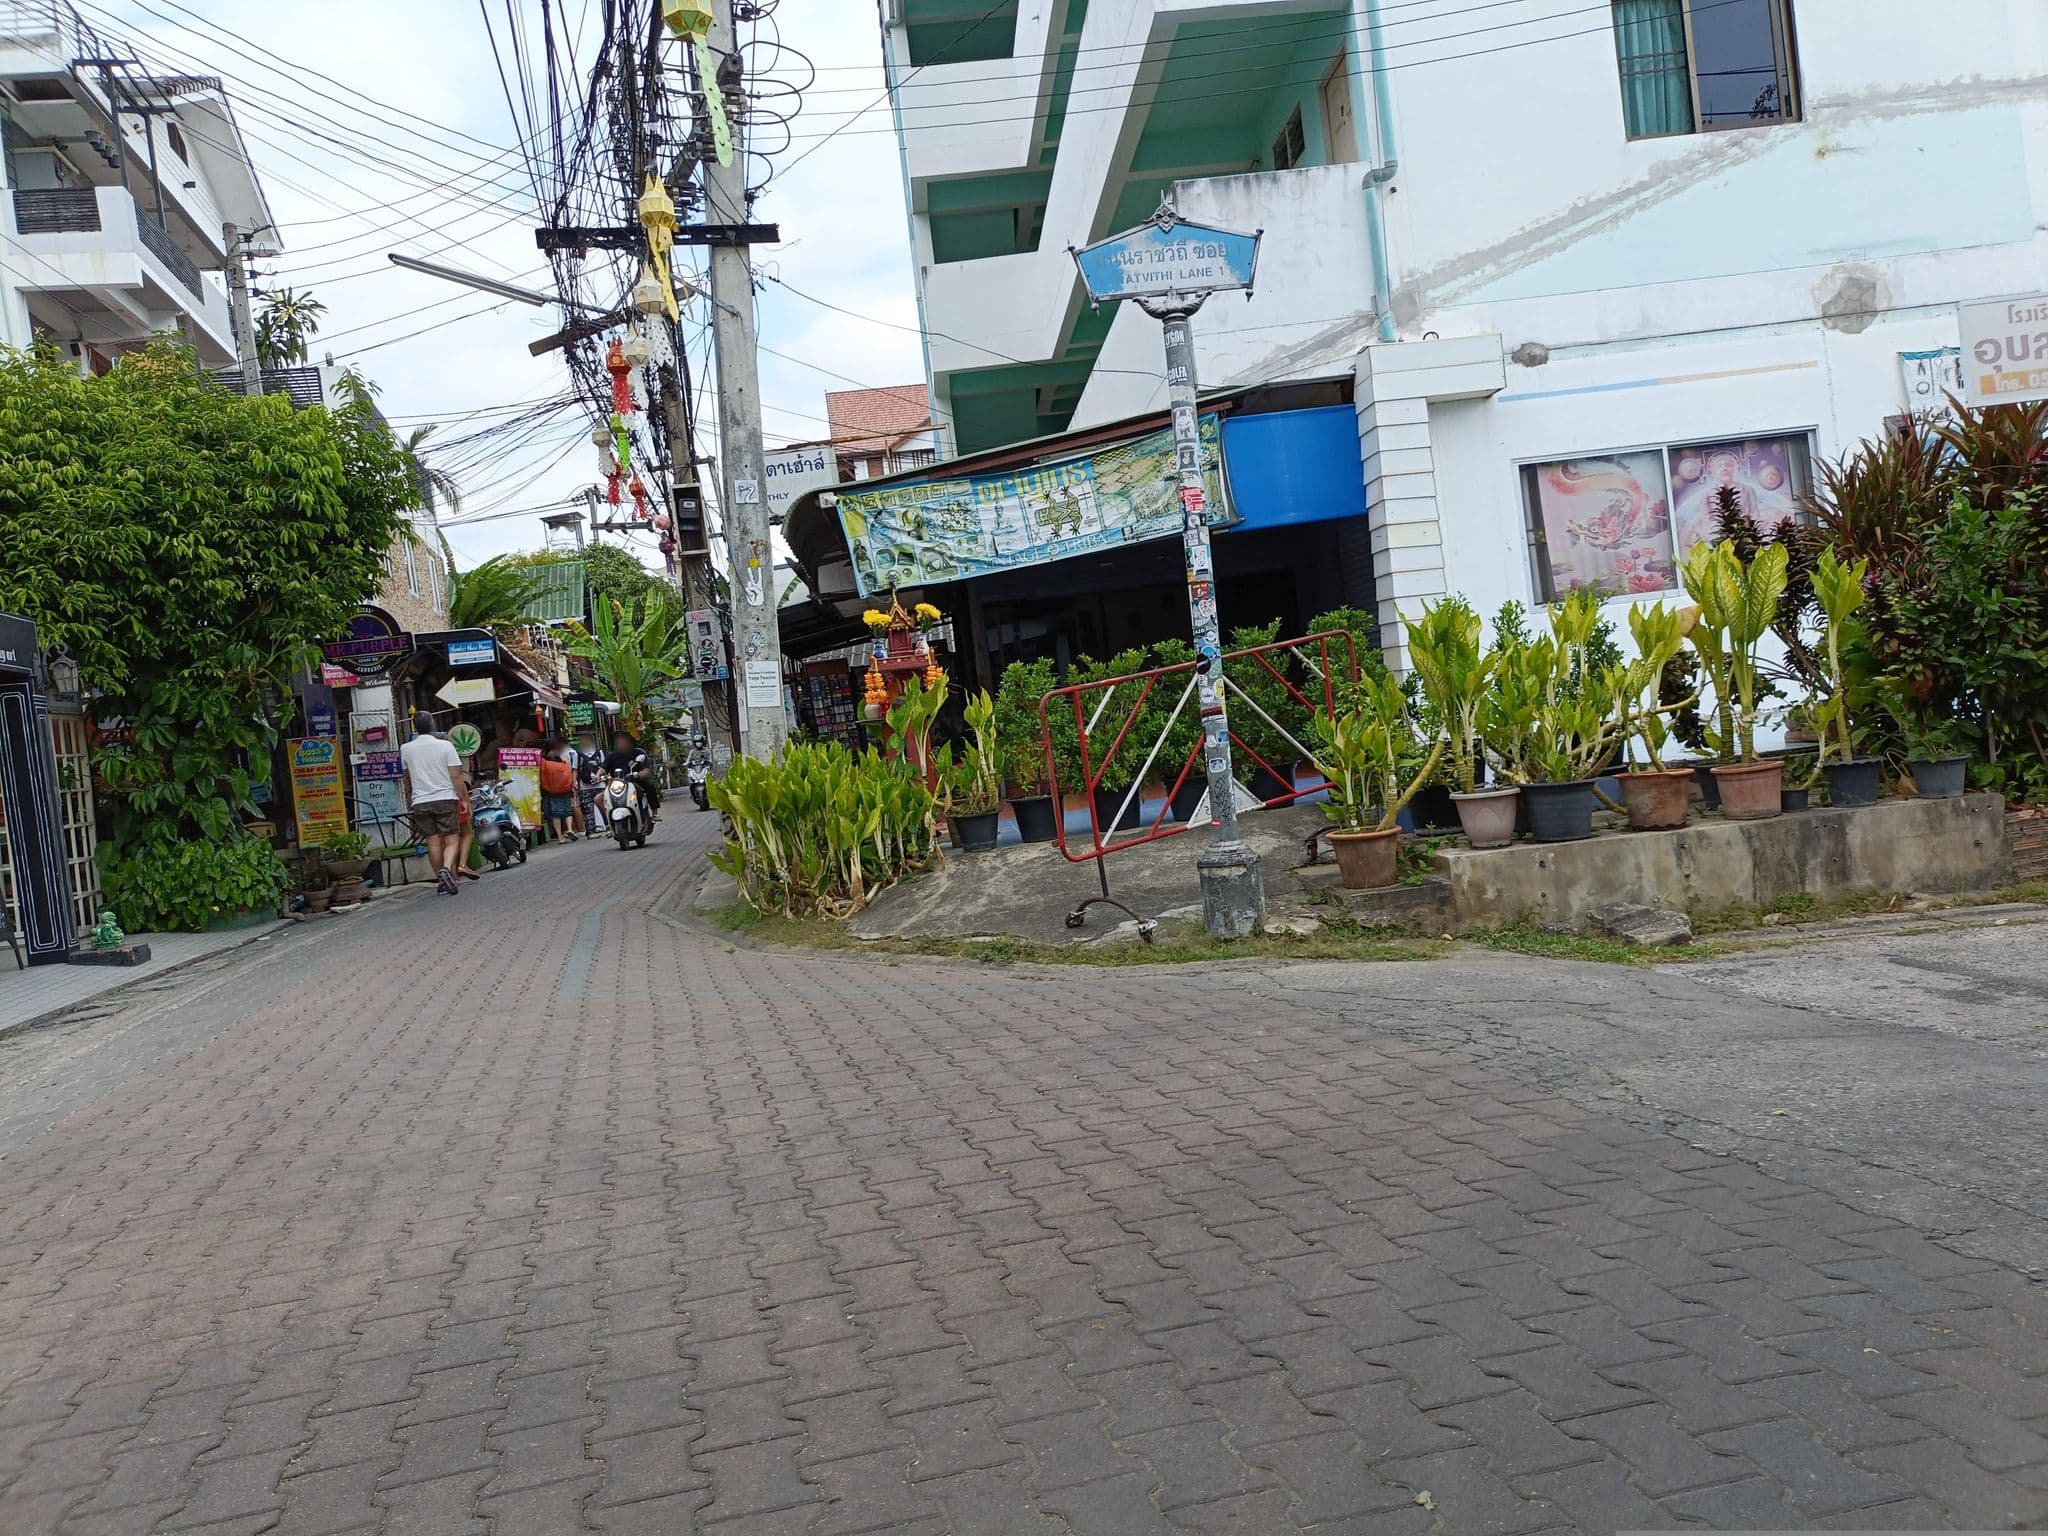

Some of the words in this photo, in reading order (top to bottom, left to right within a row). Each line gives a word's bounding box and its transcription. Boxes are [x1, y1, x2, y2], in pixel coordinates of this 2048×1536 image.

[1193, 243, 1228, 259] ซอย
[1180, 267, 1213, 279] LANE
[1219, 266, 1224, 275] 1
[767, 492, 789, 501] THLY
[1062, 533, 1117, 553] TRIBAL
[351, 637, 408, 654] PURPLE
